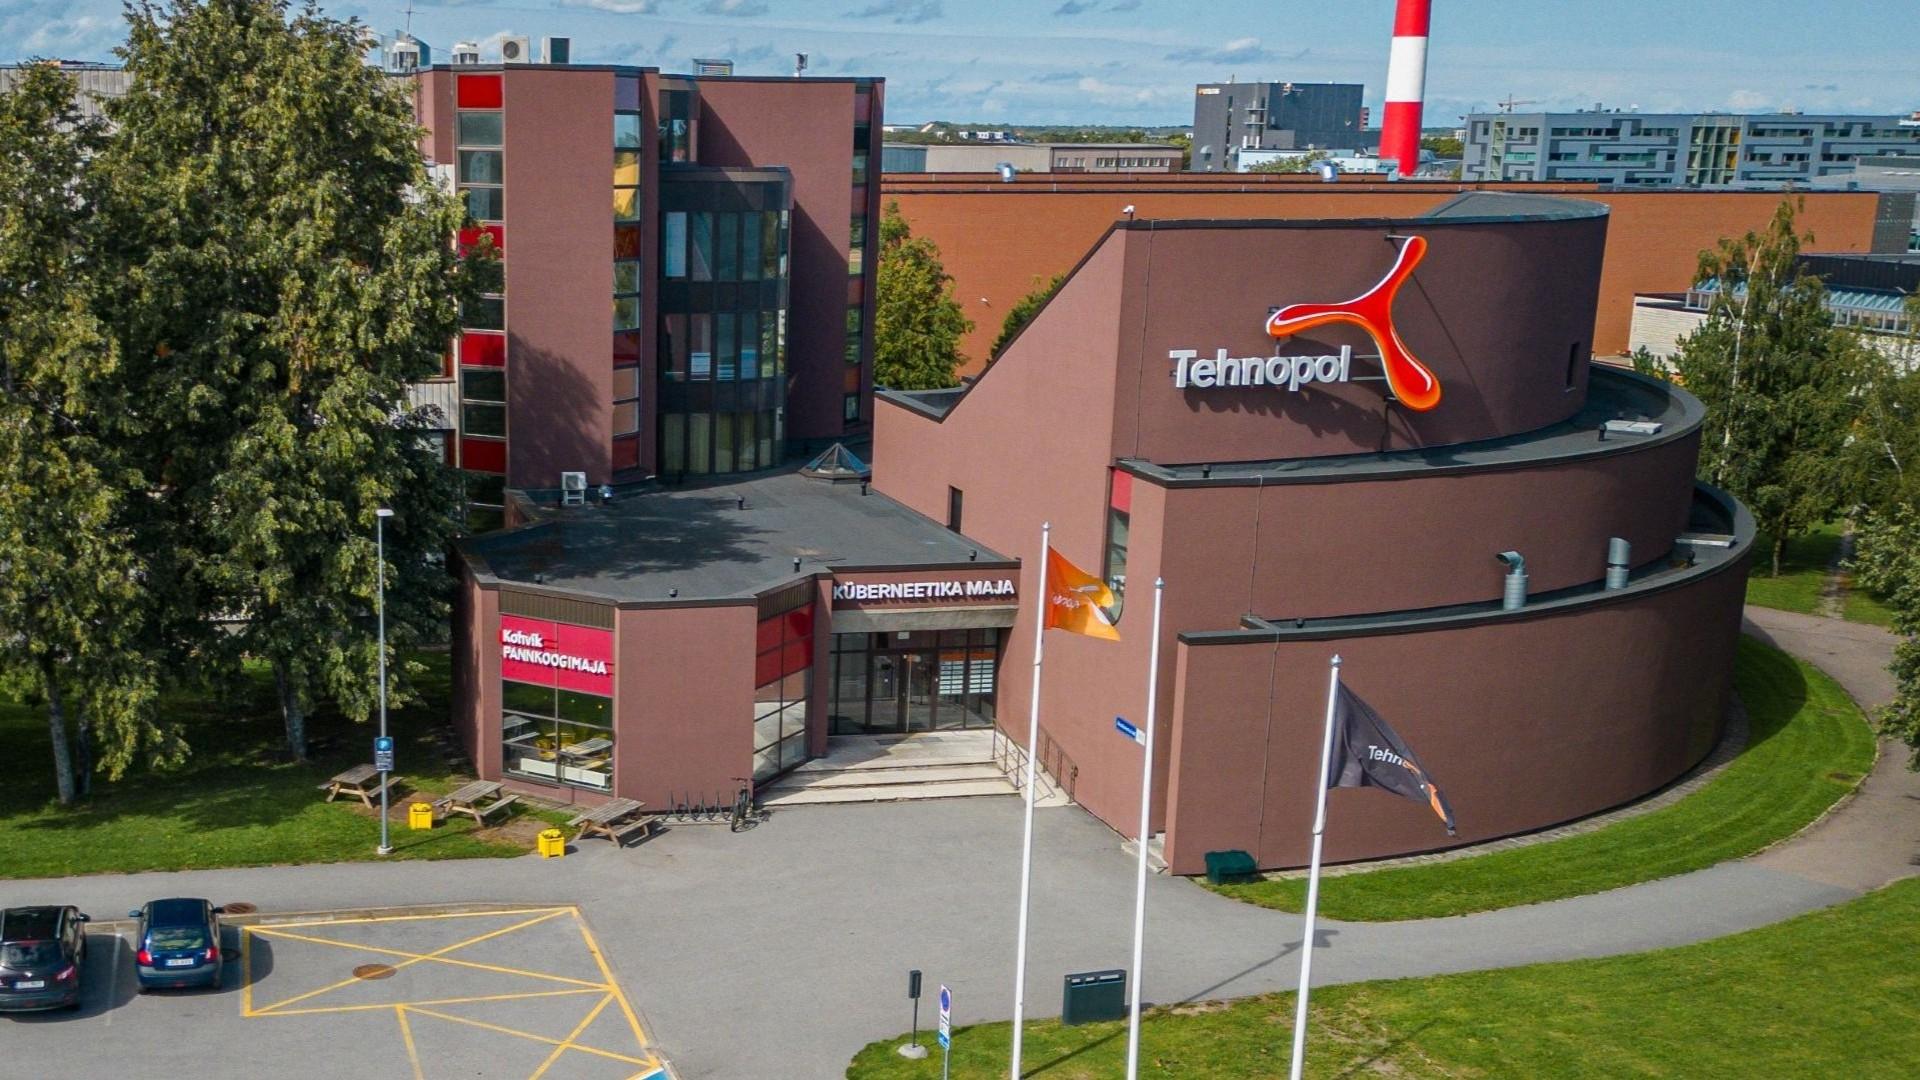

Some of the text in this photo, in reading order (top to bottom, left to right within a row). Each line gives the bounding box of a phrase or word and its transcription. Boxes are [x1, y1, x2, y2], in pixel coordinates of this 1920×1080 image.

[1169, 345, 1351, 391] Tehnopol
[833, 580, 1015, 600] KÜBERNEETIKA MAJA
[502, 629, 544, 647] Kohvik
[503, 645, 607, 675] PANNKOOGIMAJA
